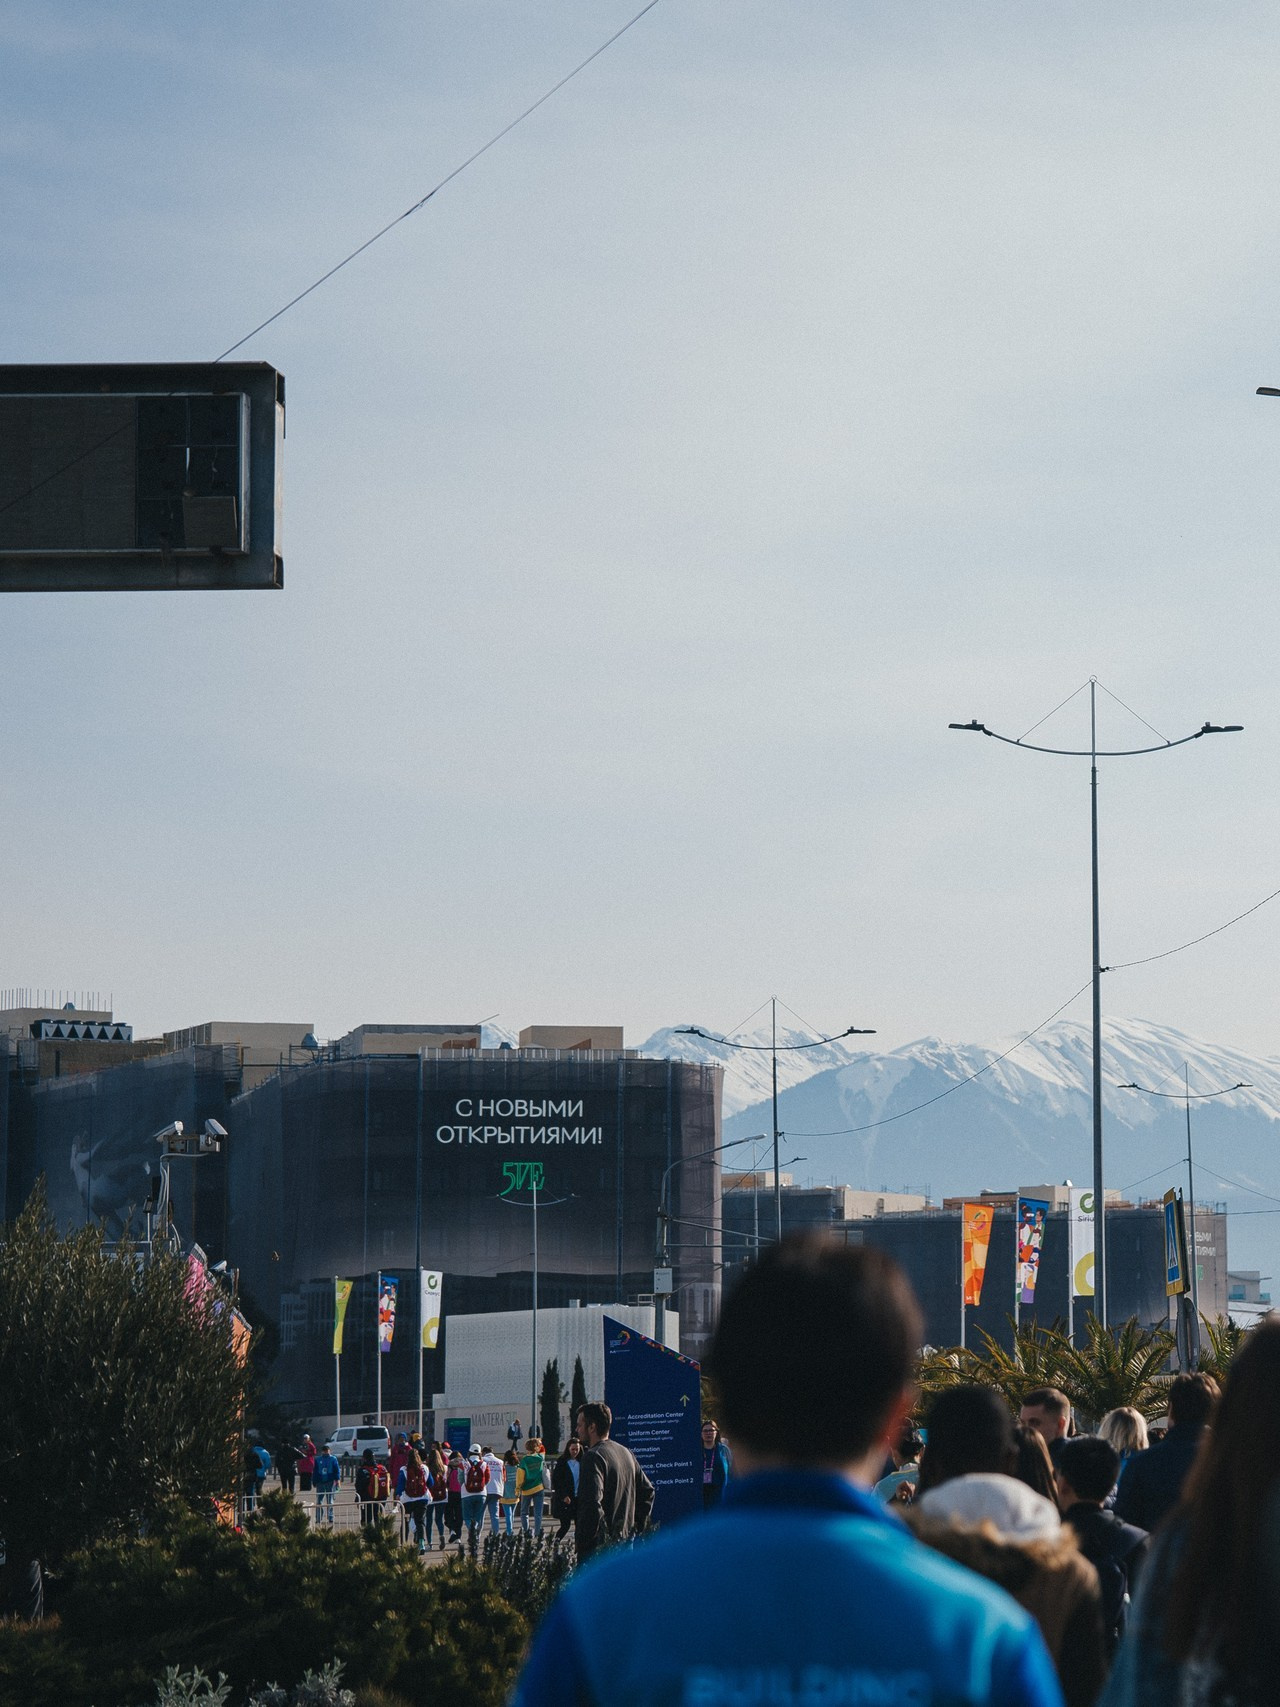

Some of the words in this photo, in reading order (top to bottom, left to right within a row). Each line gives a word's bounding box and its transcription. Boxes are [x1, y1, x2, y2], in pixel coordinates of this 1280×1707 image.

[455, 1099, 473, 1117] С
[479, 1099, 583, 1118] НОВЫМИ
[436, 1125, 603, 1144] ОТКРЫТИЯМИ!
[500, 1162, 545, 1196] 5VE
[471, 1411, 505, 1427] MANTERA
